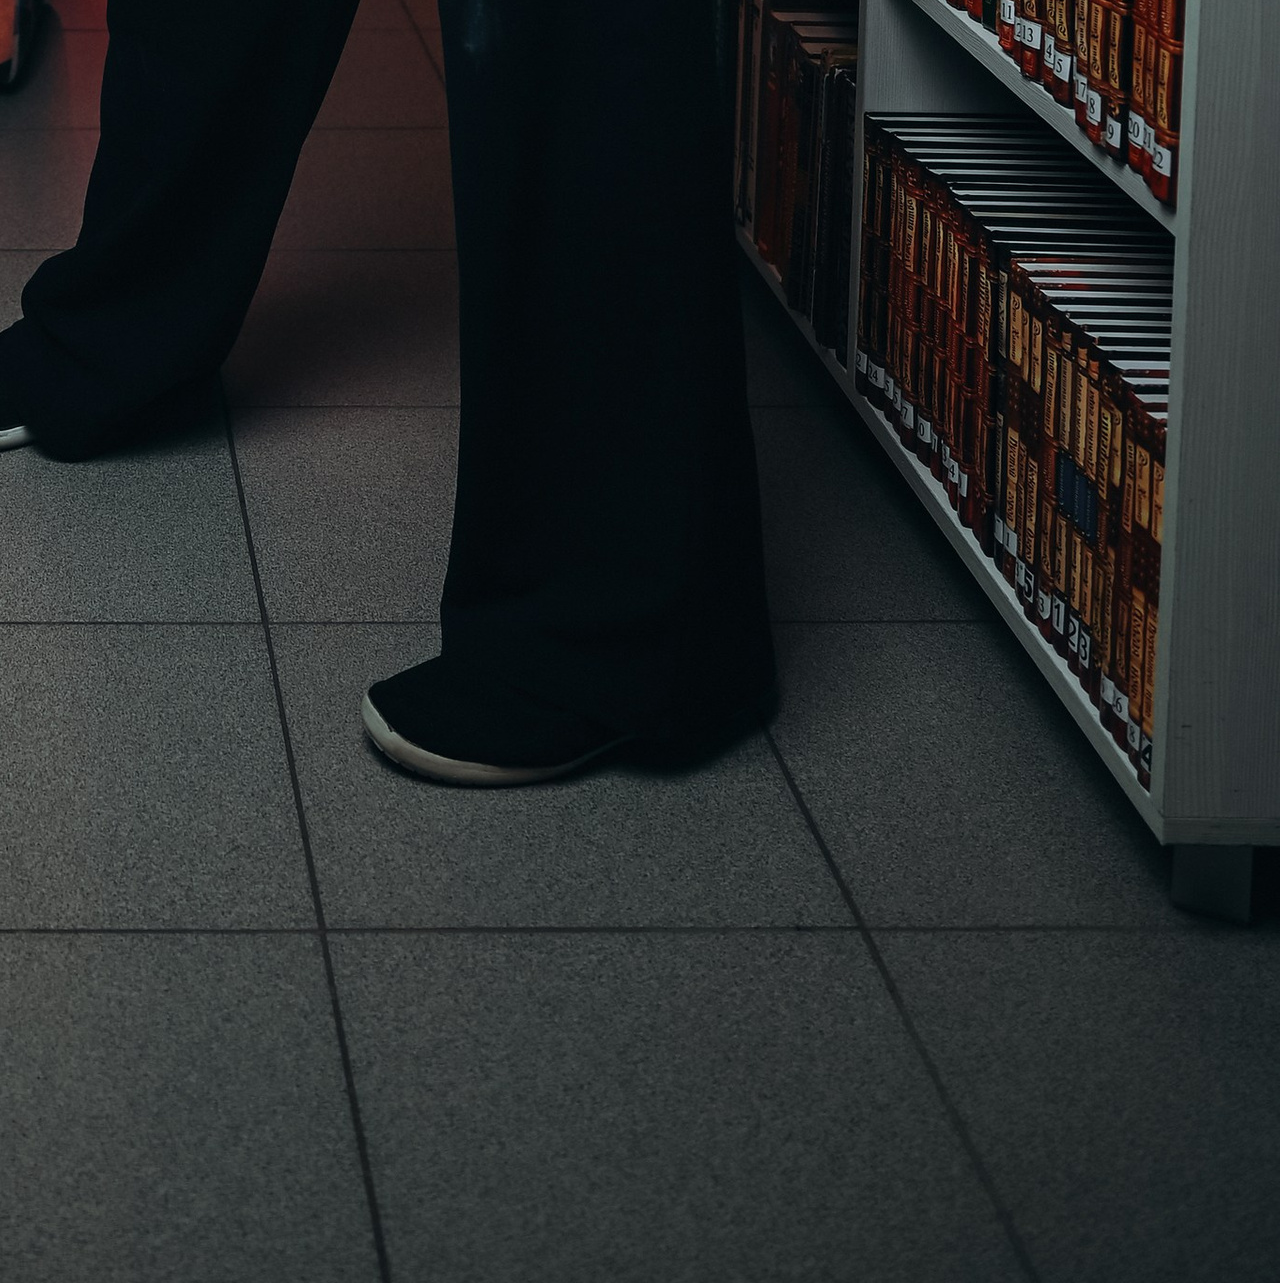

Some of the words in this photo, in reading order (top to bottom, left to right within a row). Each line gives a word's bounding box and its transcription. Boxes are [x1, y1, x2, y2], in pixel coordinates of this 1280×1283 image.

[1001, 2, 1012, 15] 11
[1022, 24, 1034, 42] 13
[1091, 5, 1100, 43] Хантер
[1109, 14, 1118, 52] Хантер
[1075, 79, 1086, 96] 17
[1107, 123, 1114, 140] 9
[1128, 118, 1140, 139] 20
[1024, 573, 1033, 598] 5
[1054, 603, 1061, 628] 1
[1068, 624, 1078, 648] 2
[1080, 635, 1088, 661] 3
